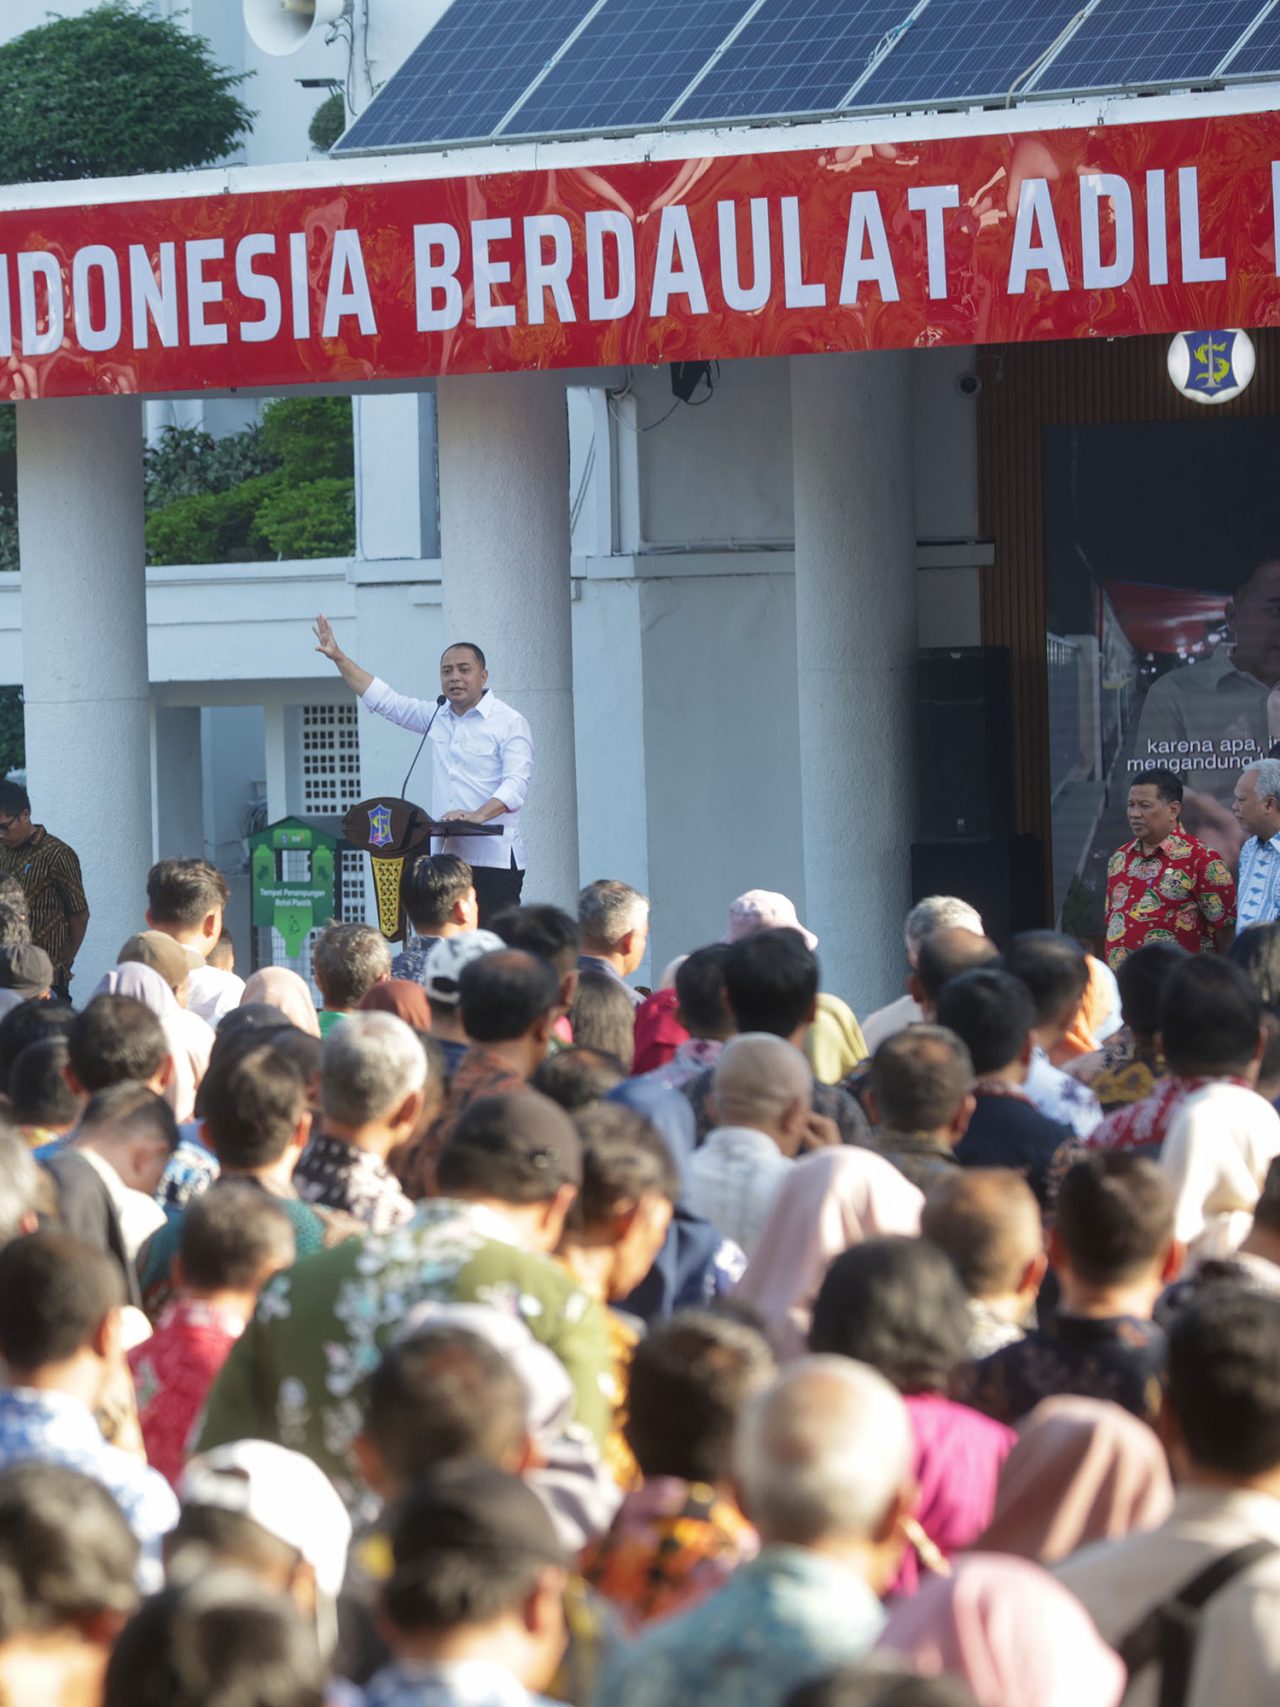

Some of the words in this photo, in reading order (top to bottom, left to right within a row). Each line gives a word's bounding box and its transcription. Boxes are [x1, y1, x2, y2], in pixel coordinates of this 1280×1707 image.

[413, 185, 960, 332] BERDAULAT
[1007, 166, 1227, 294] ADIL
[1147, 738, 1214, 754] karena
[1220, 738, 1261, 755] apa,
[1127, 753, 1253, 774] mengandung
